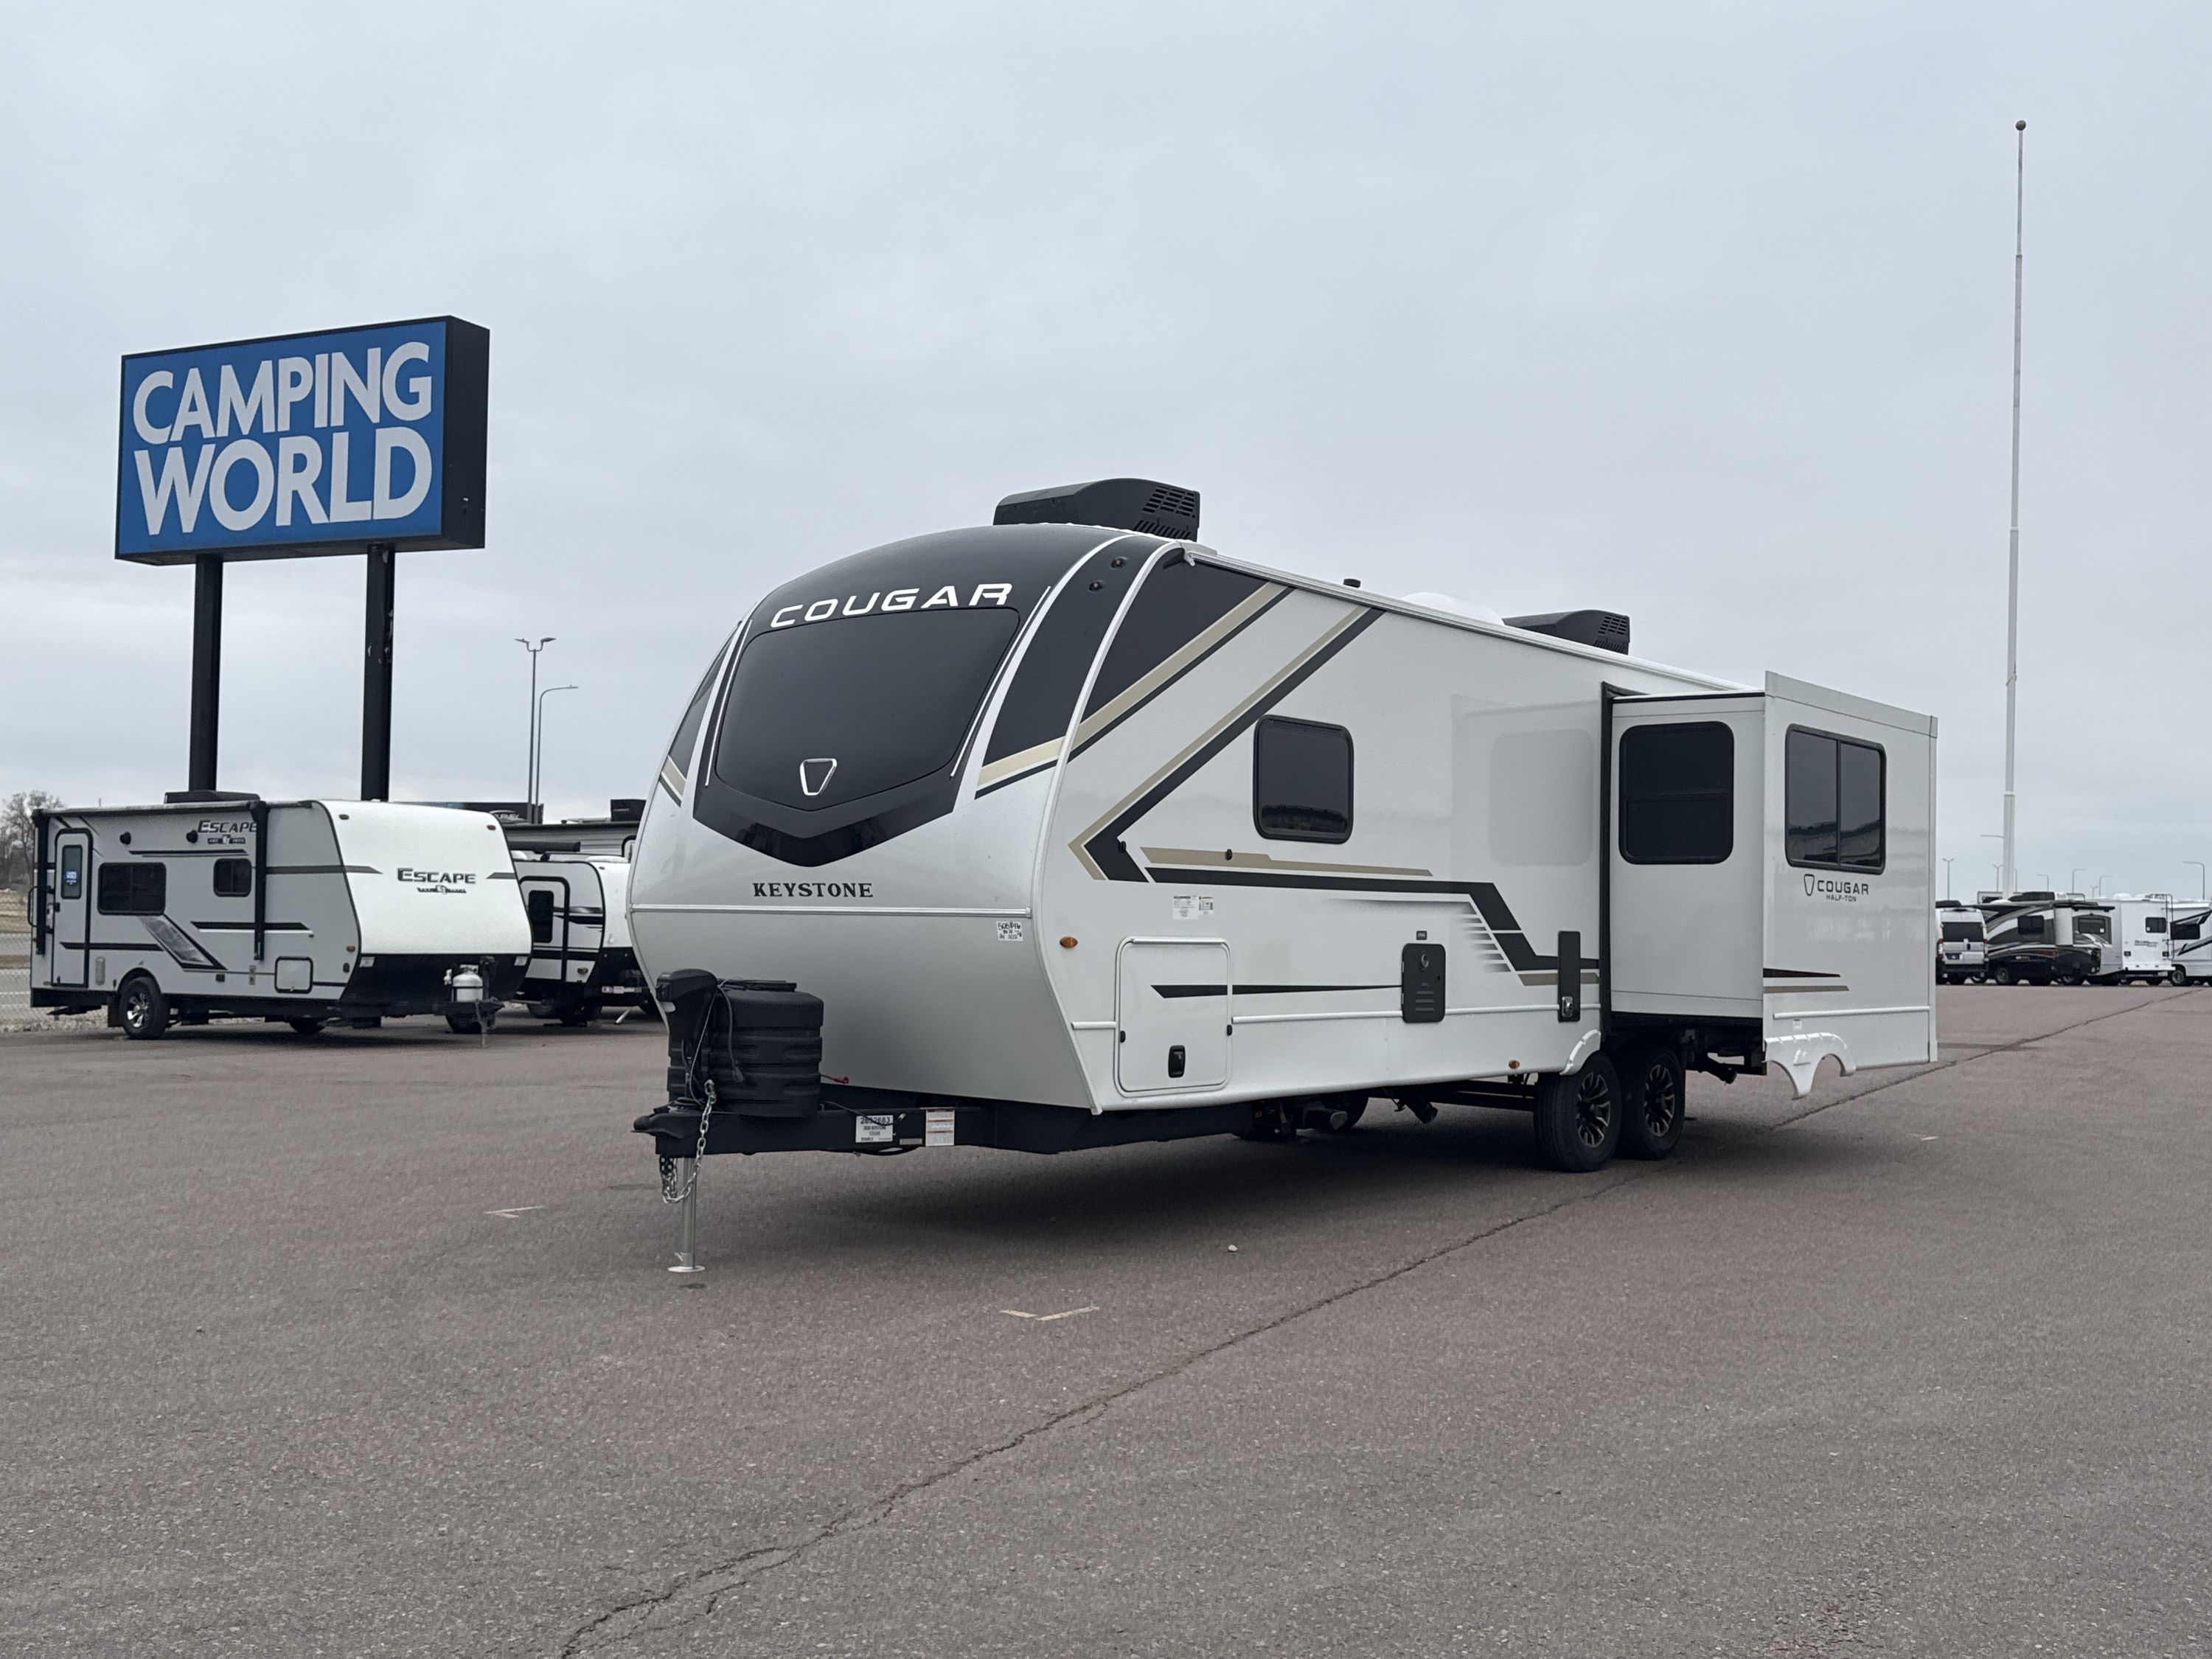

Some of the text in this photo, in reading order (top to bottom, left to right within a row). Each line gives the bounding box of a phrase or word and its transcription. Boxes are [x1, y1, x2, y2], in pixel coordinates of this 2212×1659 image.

[133, 341, 432, 445] CAMPING
[133, 426, 433, 536] WORLD
[771, 582, 1013, 628] COUGAR
[198, 820, 257, 833] ESCAPE
[397, 868, 476, 884] ESCAPE
[752, 883, 874, 898] KEYSTONE
[1817, 880, 1869, 896] COUGAR
[1826, 894, 1857, 902] HALF-TON
